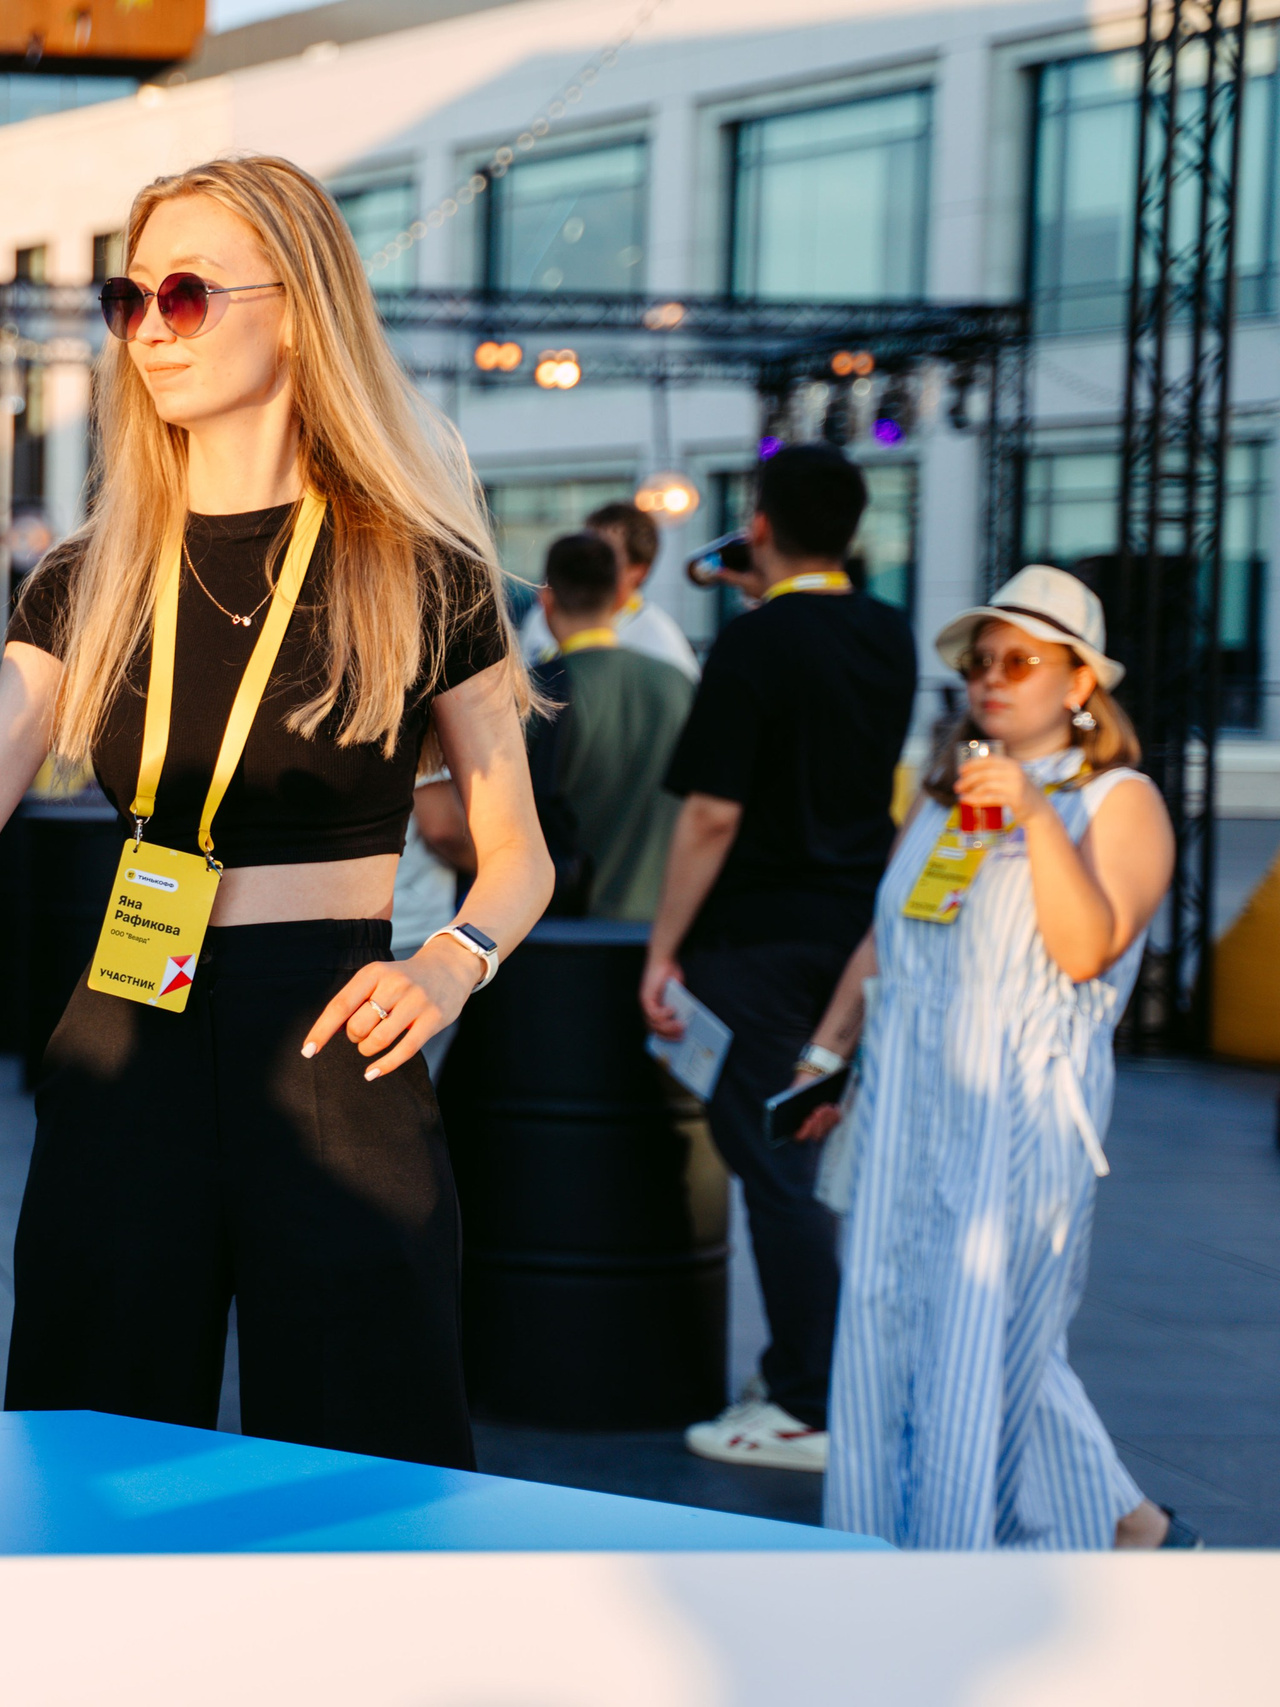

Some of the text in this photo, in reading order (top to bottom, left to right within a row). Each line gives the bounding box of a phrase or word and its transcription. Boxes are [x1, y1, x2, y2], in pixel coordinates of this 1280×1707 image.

[138, 874, 175, 888] ТИНЬКОФФ
[118, 895, 143, 910] Яна
[114, 910, 181, 936] Рафикова
[110, 928, 125, 937] ООО
[100, 967, 156, 991] УЧАСТНИК
